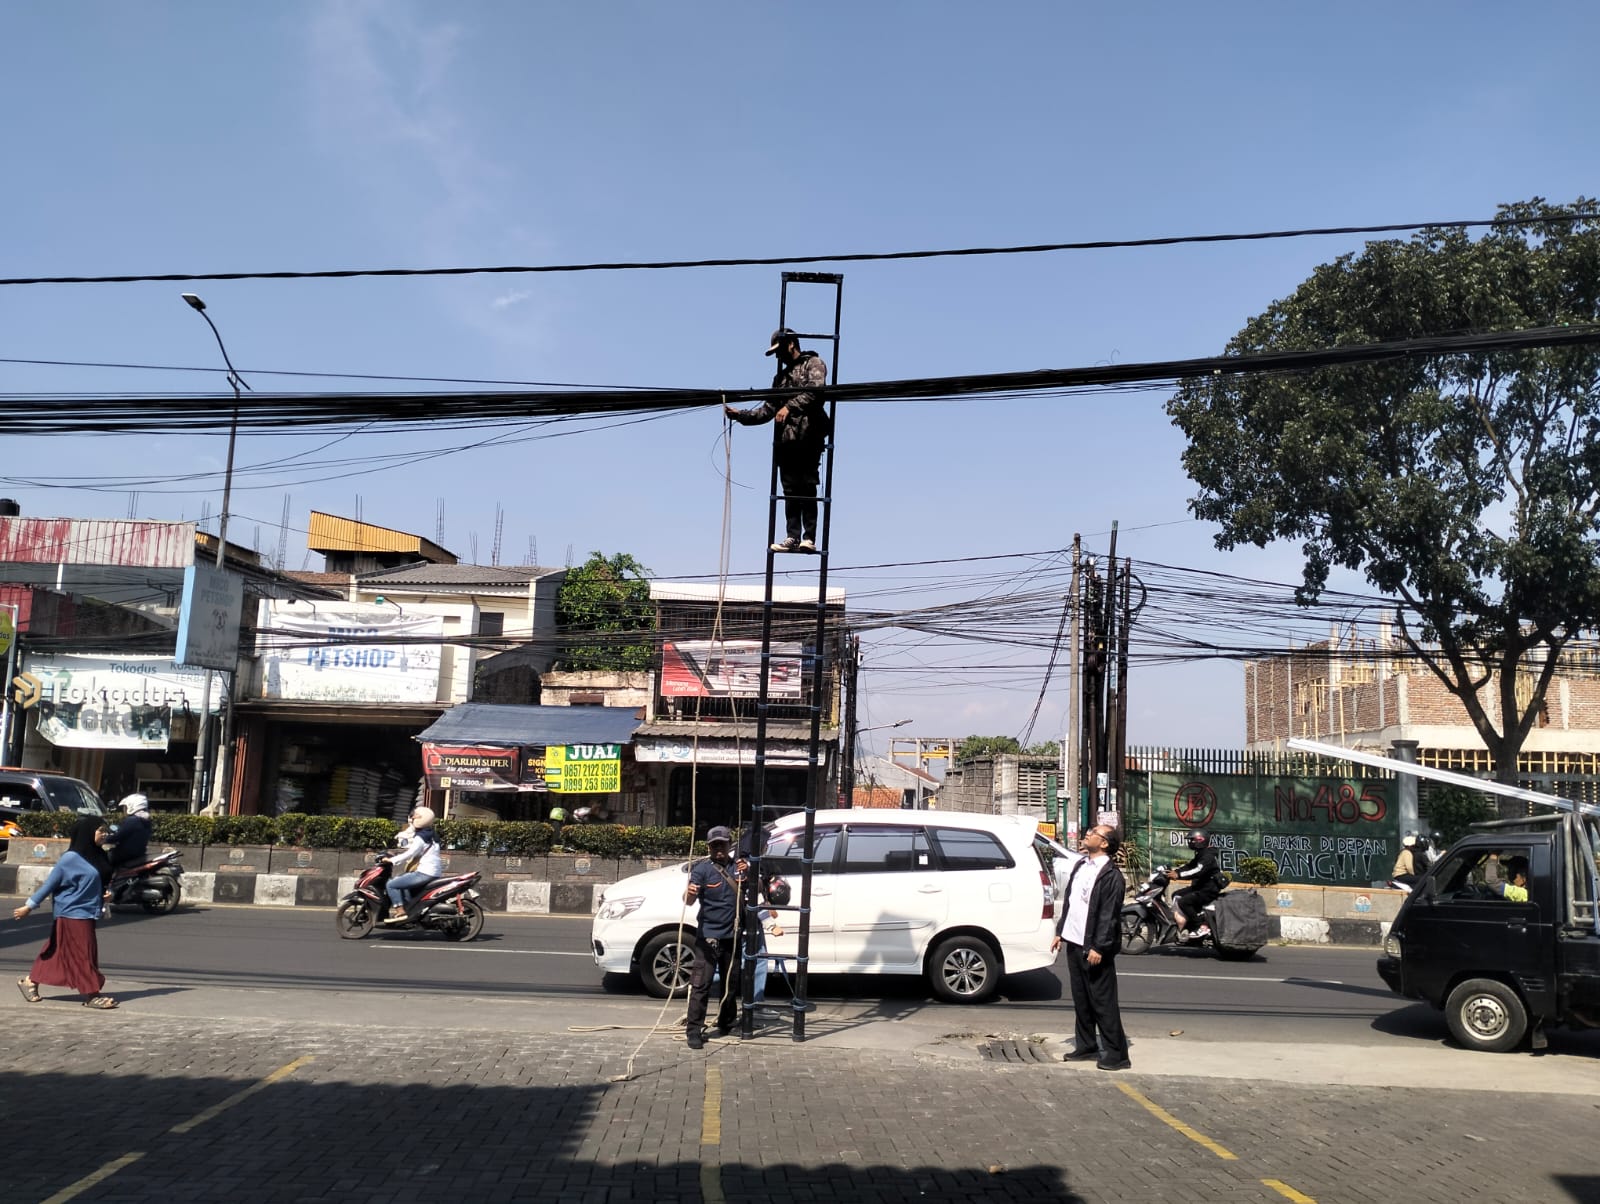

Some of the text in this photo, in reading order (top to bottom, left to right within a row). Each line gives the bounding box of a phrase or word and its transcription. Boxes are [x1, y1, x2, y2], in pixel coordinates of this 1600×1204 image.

[307, 647, 395, 668] PETSHOP
[109, 662, 157, 675] Tokodus
[52, 676, 184, 707] Tokodus
[569, 745, 617, 760] JUAL
[445, 757, 509, 767] DJARUM SUPER
[564, 763, 618, 777] 0857 2122 9258
[564, 777, 582, 791] 0899
[585, 778, 598, 790] 253
[1263, 835, 1387, 855] PARKIR DI DEPAN
